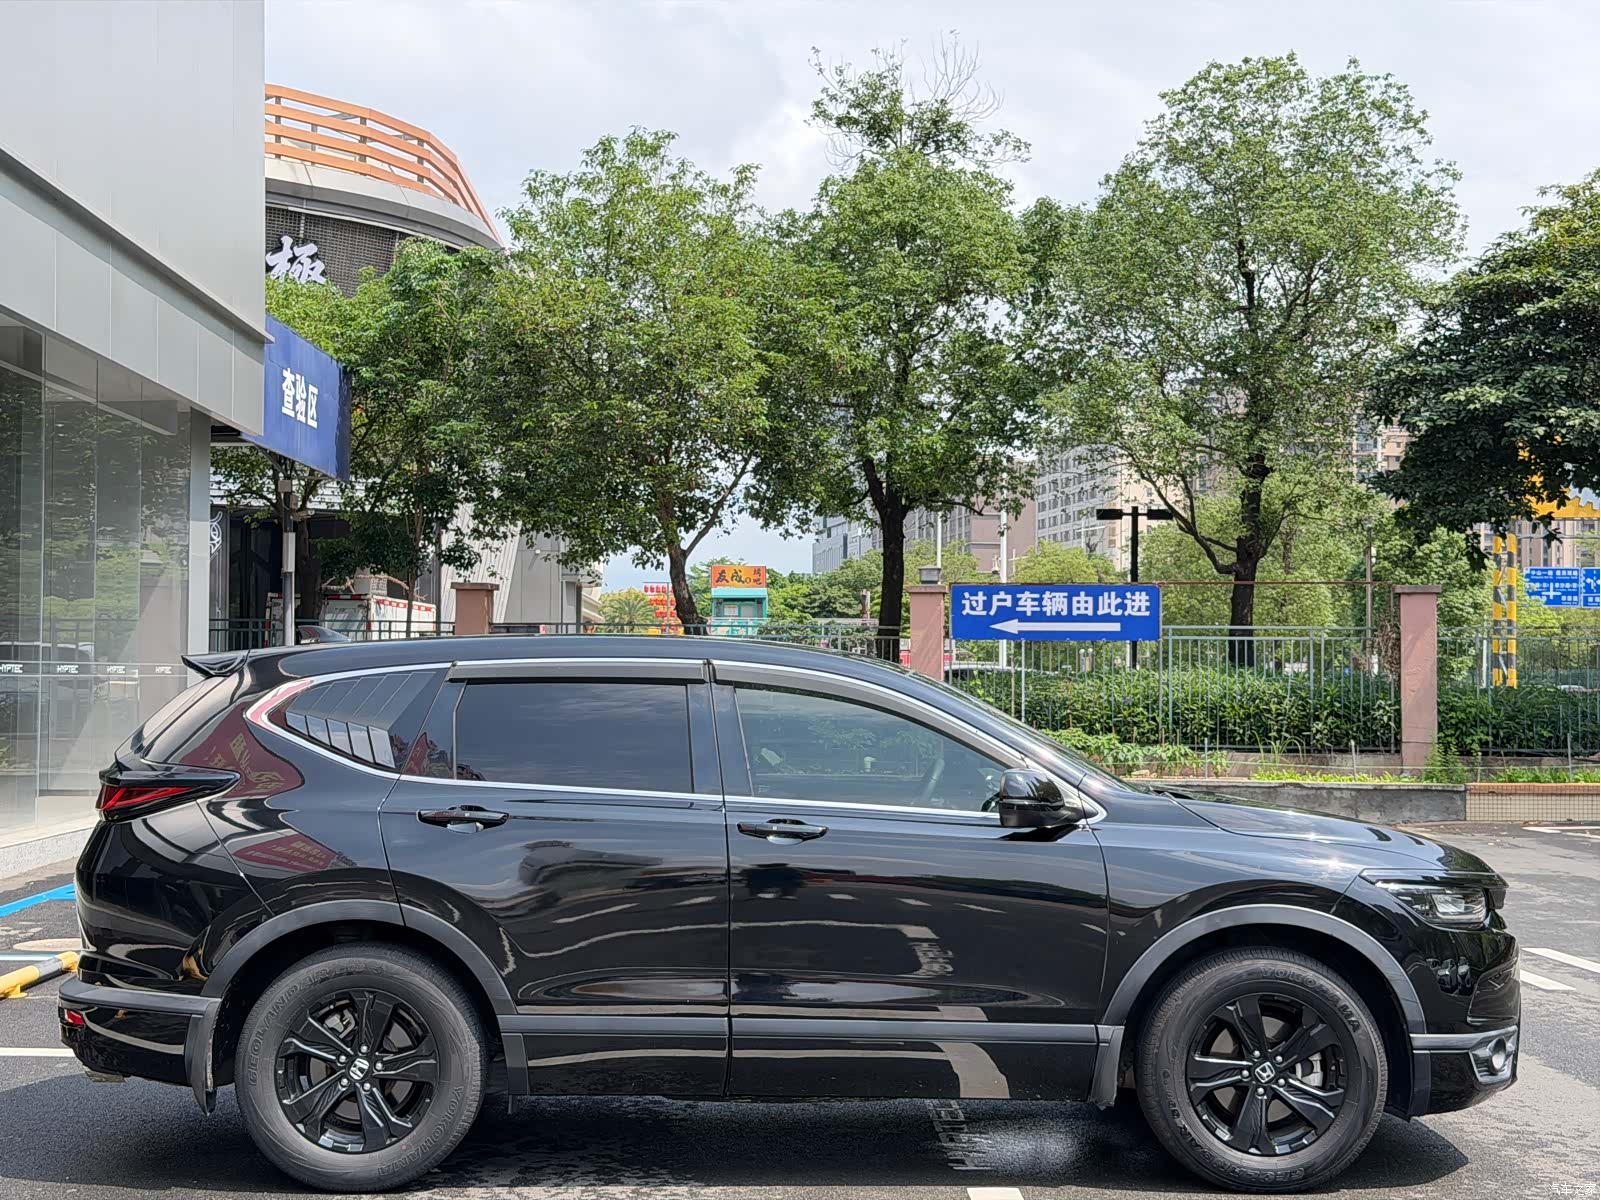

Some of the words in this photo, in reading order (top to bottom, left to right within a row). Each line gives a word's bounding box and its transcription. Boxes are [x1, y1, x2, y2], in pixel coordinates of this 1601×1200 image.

[282, 368, 319, 429] 查验区
[961, 591, 1150, 616] 过户车辆由此进
[0, 664, 24, 674] HYPTEC
[57, 665, 79, 674] HYPTEC
[106, 665, 126, 674] HYPTEC
[248, 968, 329, 1087] GEOLANDAR
[377, 1085, 465, 1176] YOKOHAMA
